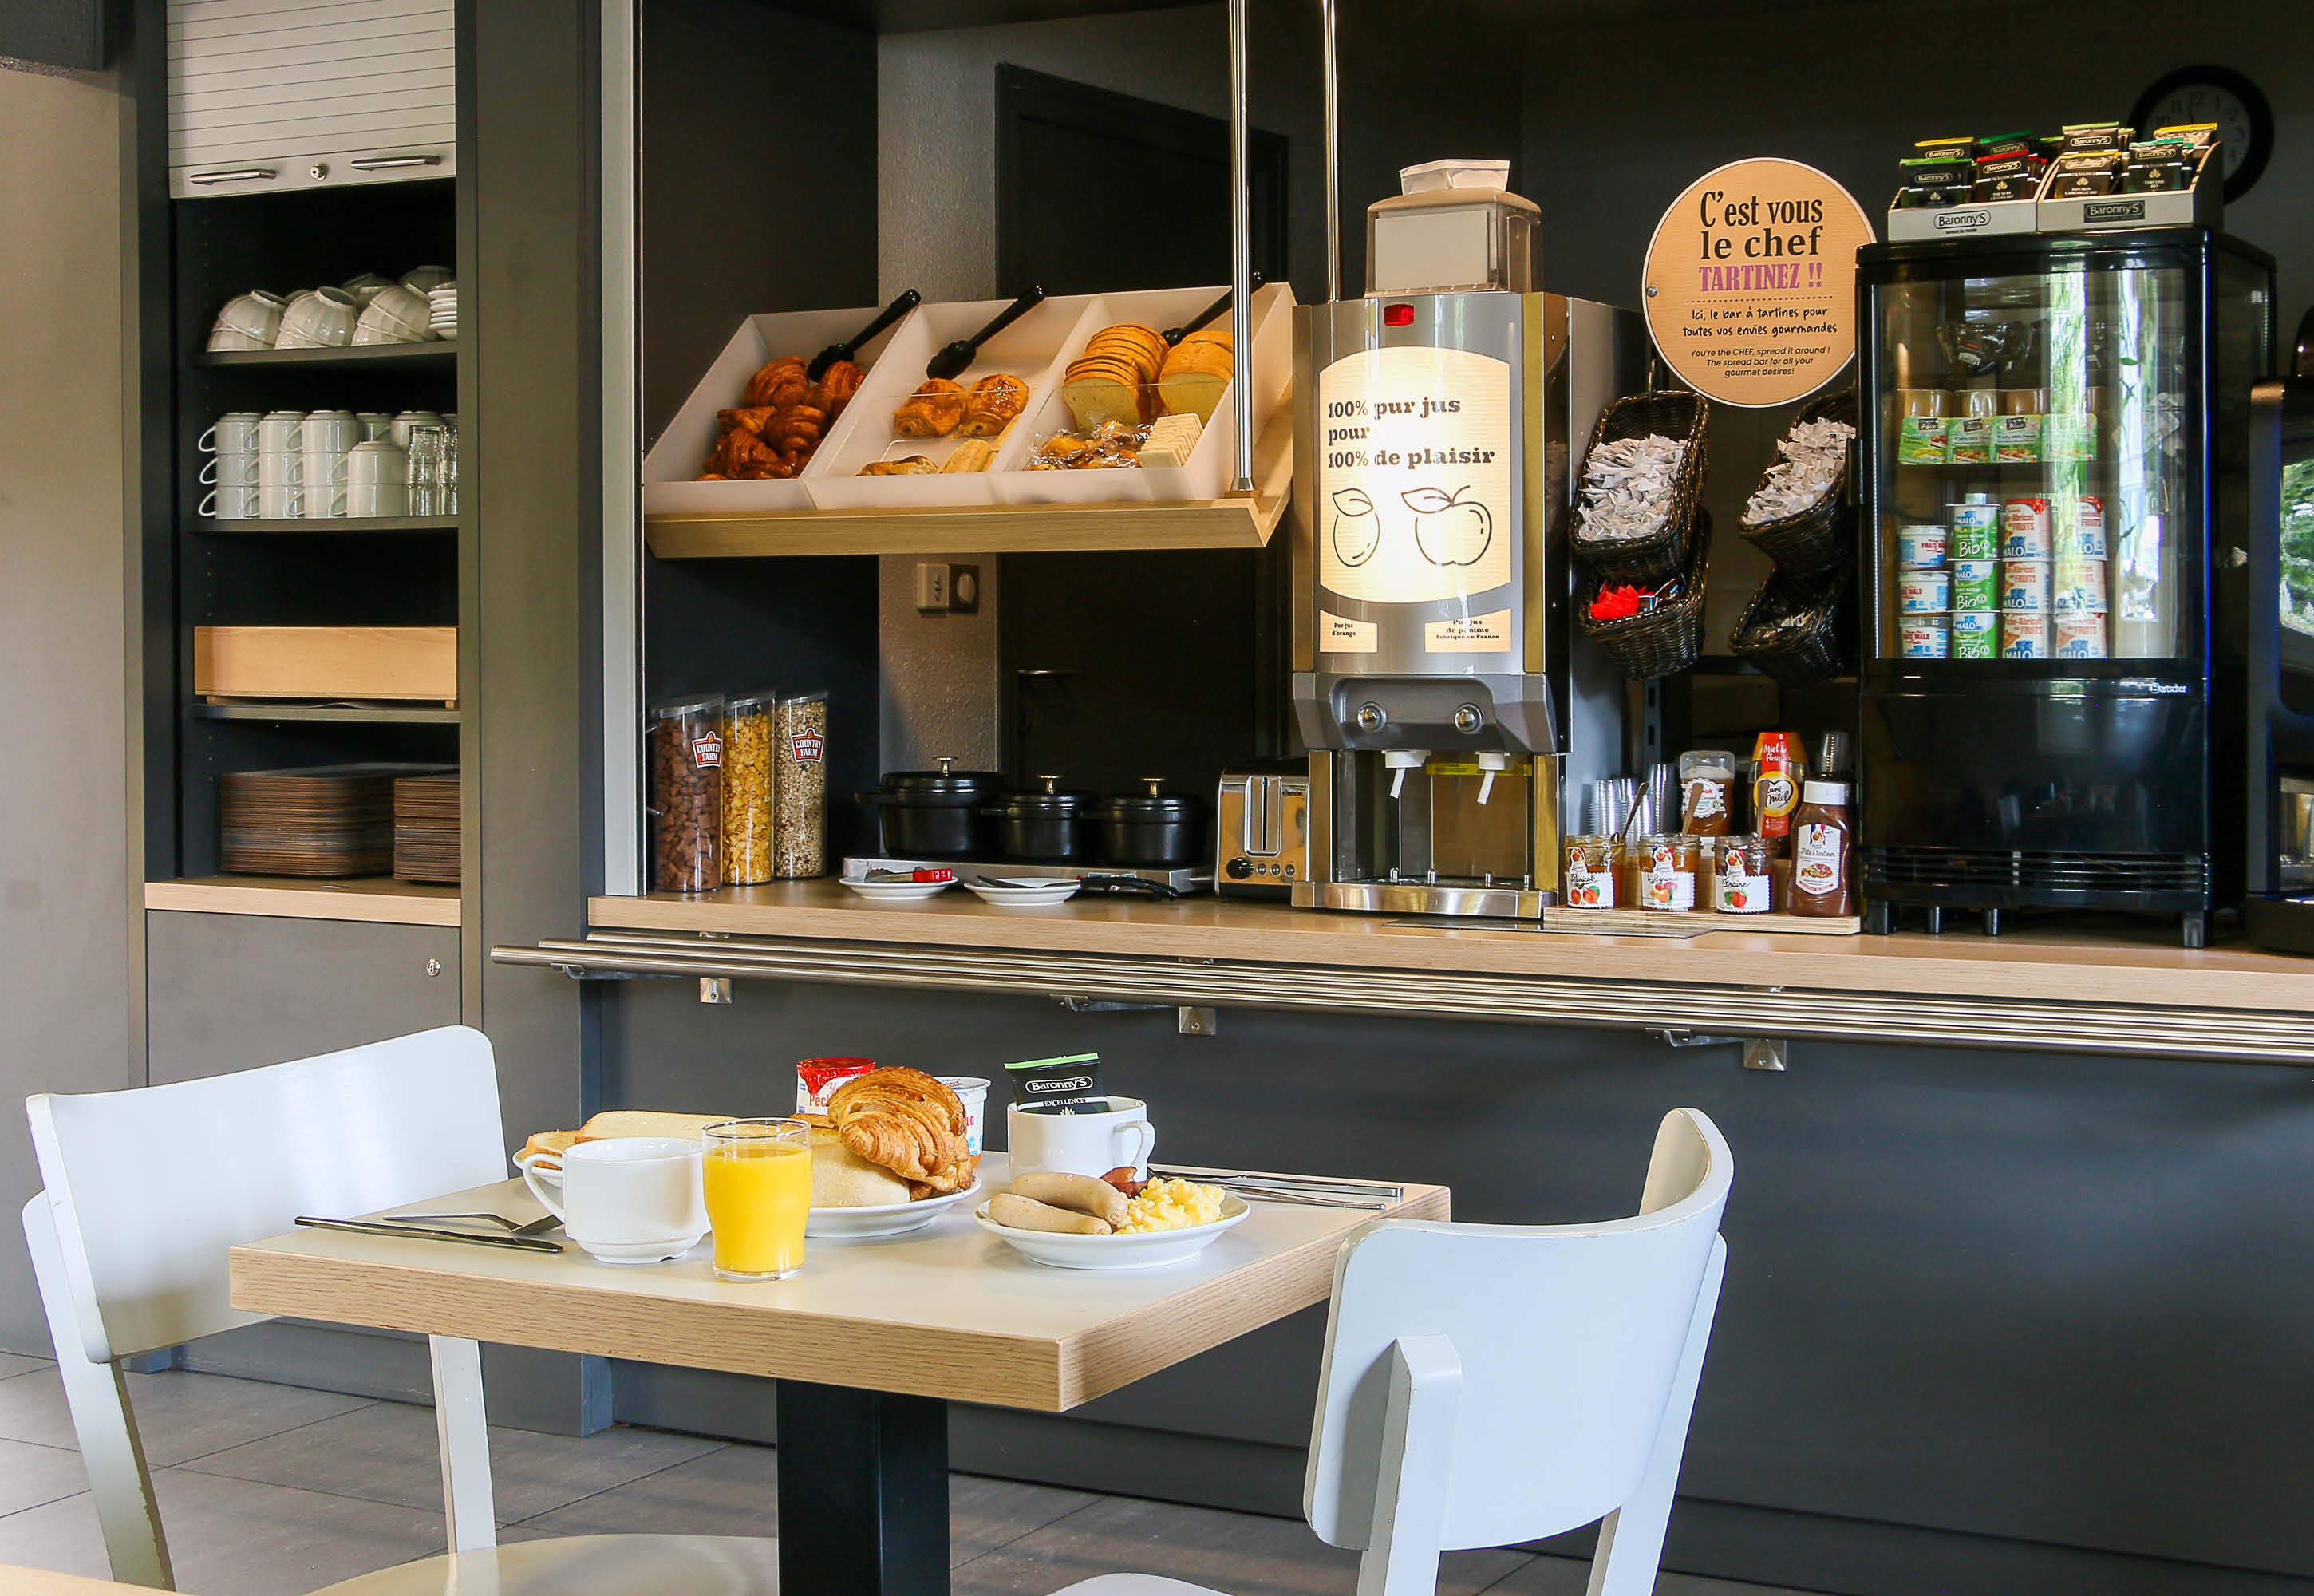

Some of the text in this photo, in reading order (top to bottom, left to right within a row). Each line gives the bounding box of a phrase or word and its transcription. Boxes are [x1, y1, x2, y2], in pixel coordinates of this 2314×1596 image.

[1700, 191, 1823, 227] C'est vous
[2091, 203, 2139, 216] Baronny'S
[1938, 213, 1986, 227] Baronny'S
[1700, 226, 1823, 259] le chef
[1699, 263, 1800, 292] TARTINEZ
[1692, 306, 1828, 321] Ici, le bar à tartines pour
[1682, 322, 1837, 338] toutes vos envies gourmandes
[1757, 347, 1786, 357] spread
[1723, 358, 1751, 368] spread
[1795, 358, 1814, 367] your
[1724, 369, 1760, 378] gourmet
[1328, 397, 1461, 419] 100% pur jus
[1328, 426, 1370, 447] pour
[1328, 447, 1495, 471] 100% de plaisir
[1959, 541, 1980, 558] Bio
[1957, 595, 1976, 610] Bio
[1958, 646, 1980, 659] Bio
[701, 753, 718, 761] FARM
[800, 748, 819, 757] FARM
[1722, 877, 1751, 887] Fraise
[1032, 1078, 1088, 1091] Baronny'S
[1045, 1098, 1085, 1107] EXCELLENCE
